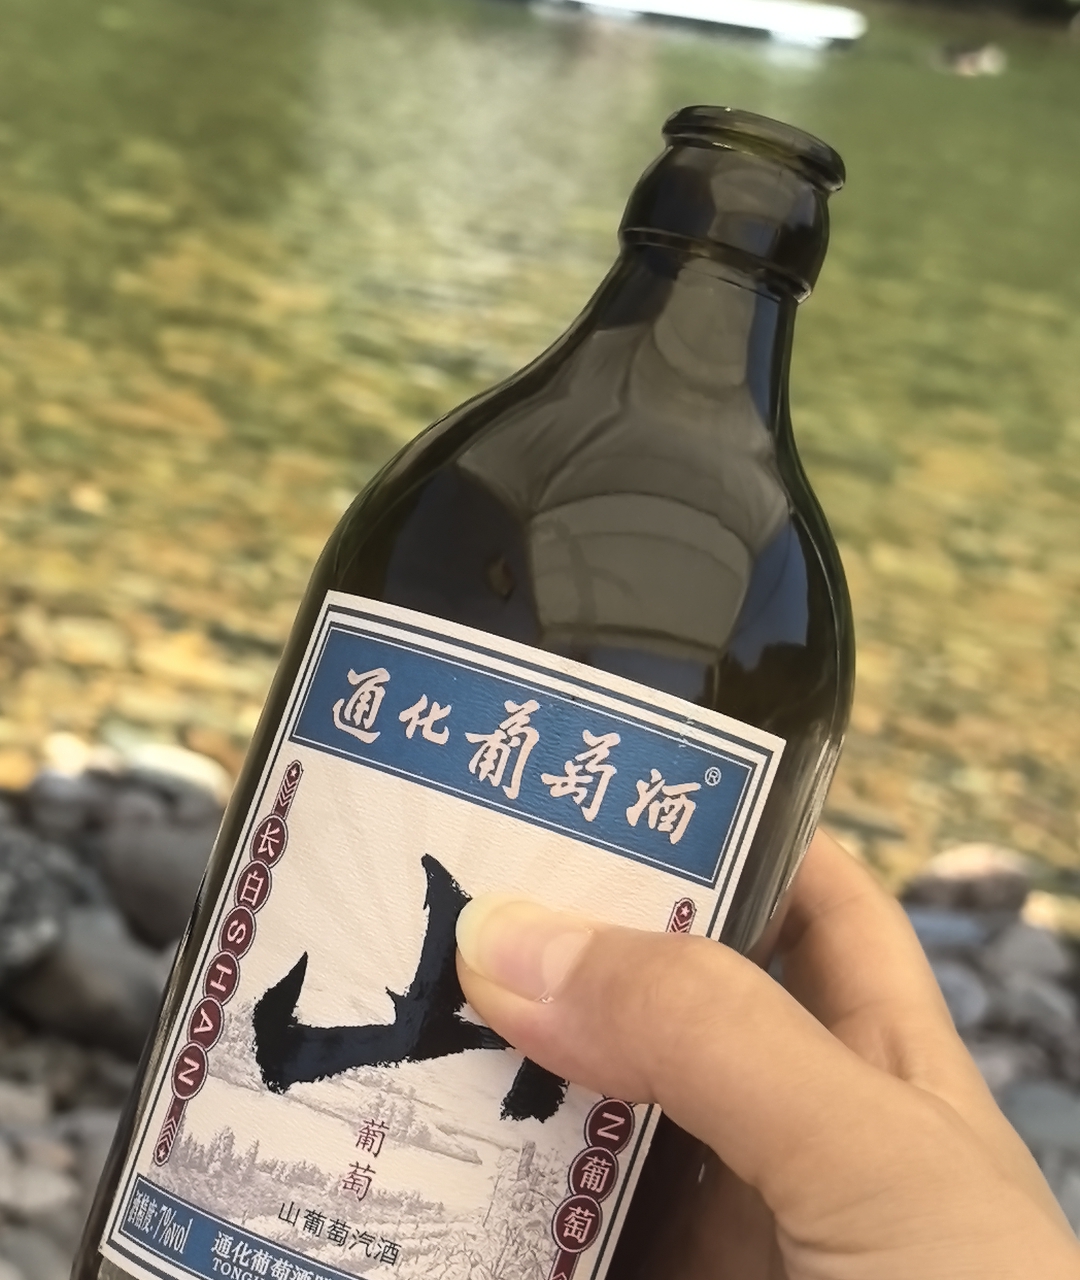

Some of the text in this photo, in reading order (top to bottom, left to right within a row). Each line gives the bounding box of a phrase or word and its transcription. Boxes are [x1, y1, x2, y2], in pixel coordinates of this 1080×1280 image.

[332, 667, 702, 845] 通化葡萄酒
[341, 1118, 390, 1203] 葡萄
[277, 1201, 402, 1267] 山葡萄汽酒
